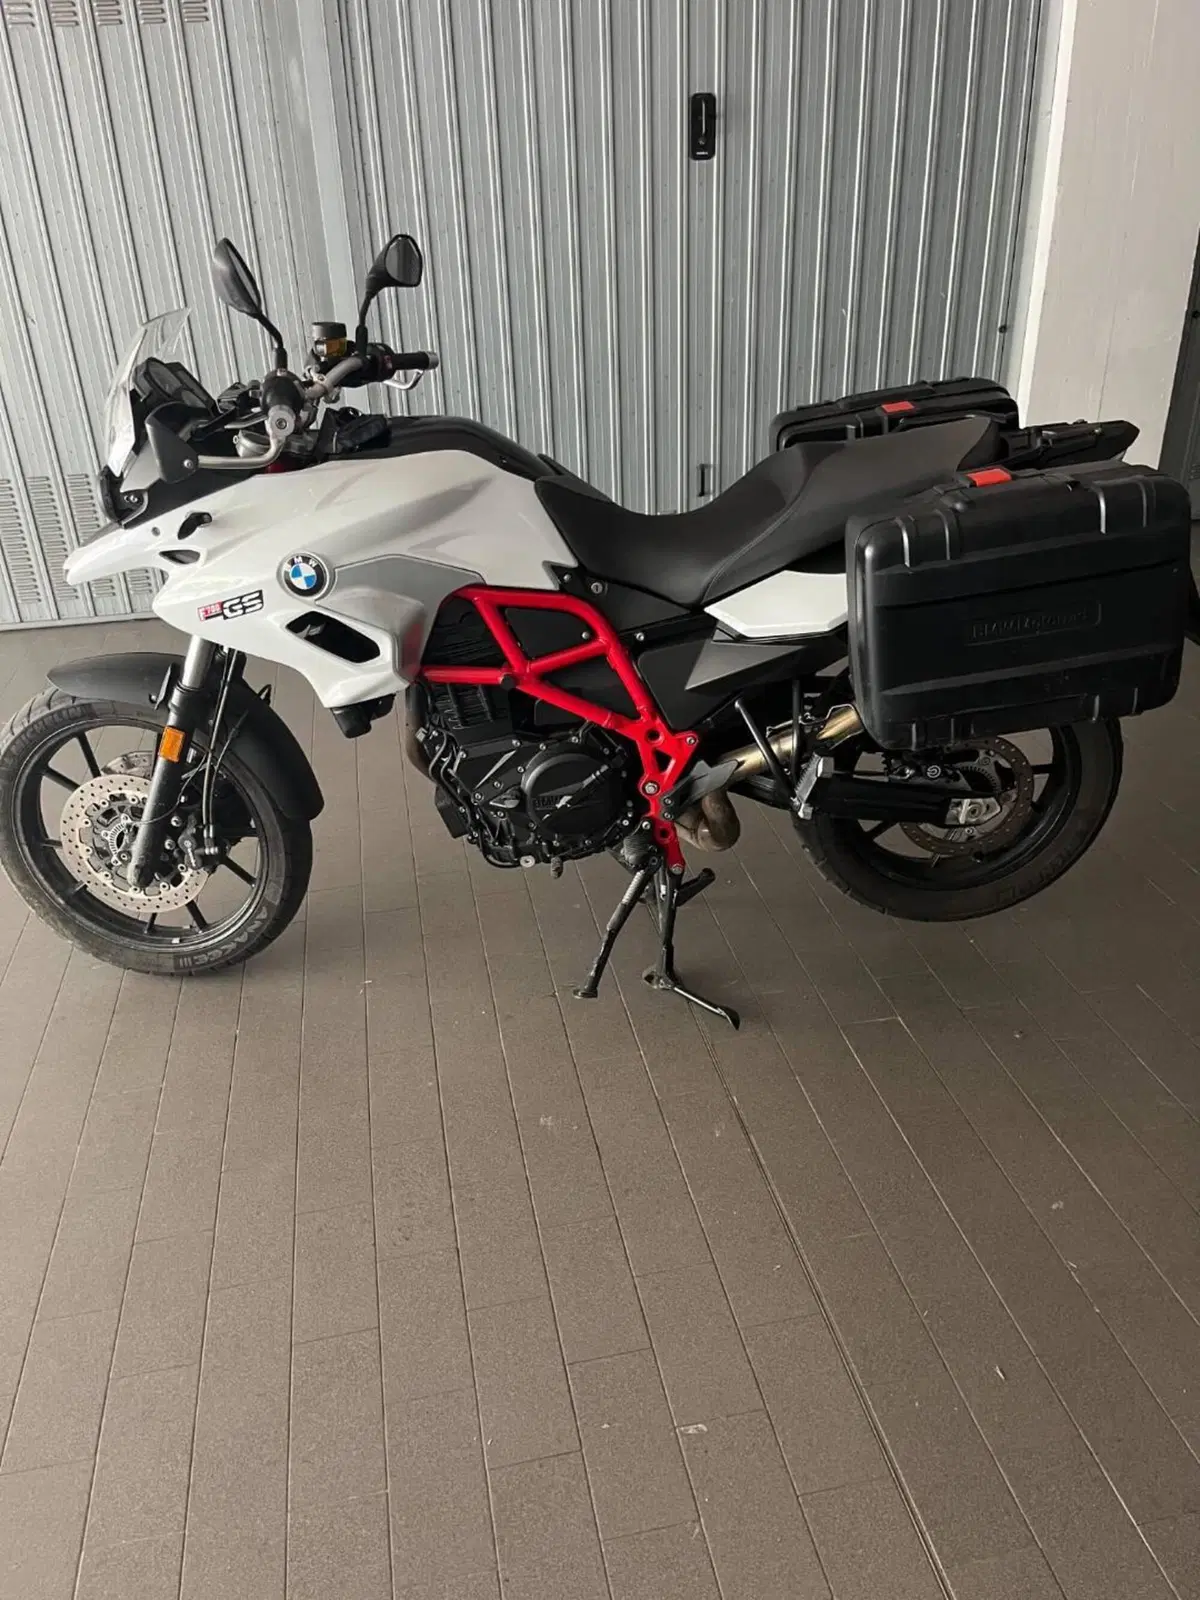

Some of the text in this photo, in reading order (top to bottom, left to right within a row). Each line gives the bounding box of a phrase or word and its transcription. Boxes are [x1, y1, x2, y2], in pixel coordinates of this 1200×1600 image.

[283, 555, 318, 572] BMW
[222, 590, 264, 620] GS
[10, 706, 82, 755] MICHELIN
[193, 905, 268, 965] ANAKEE
